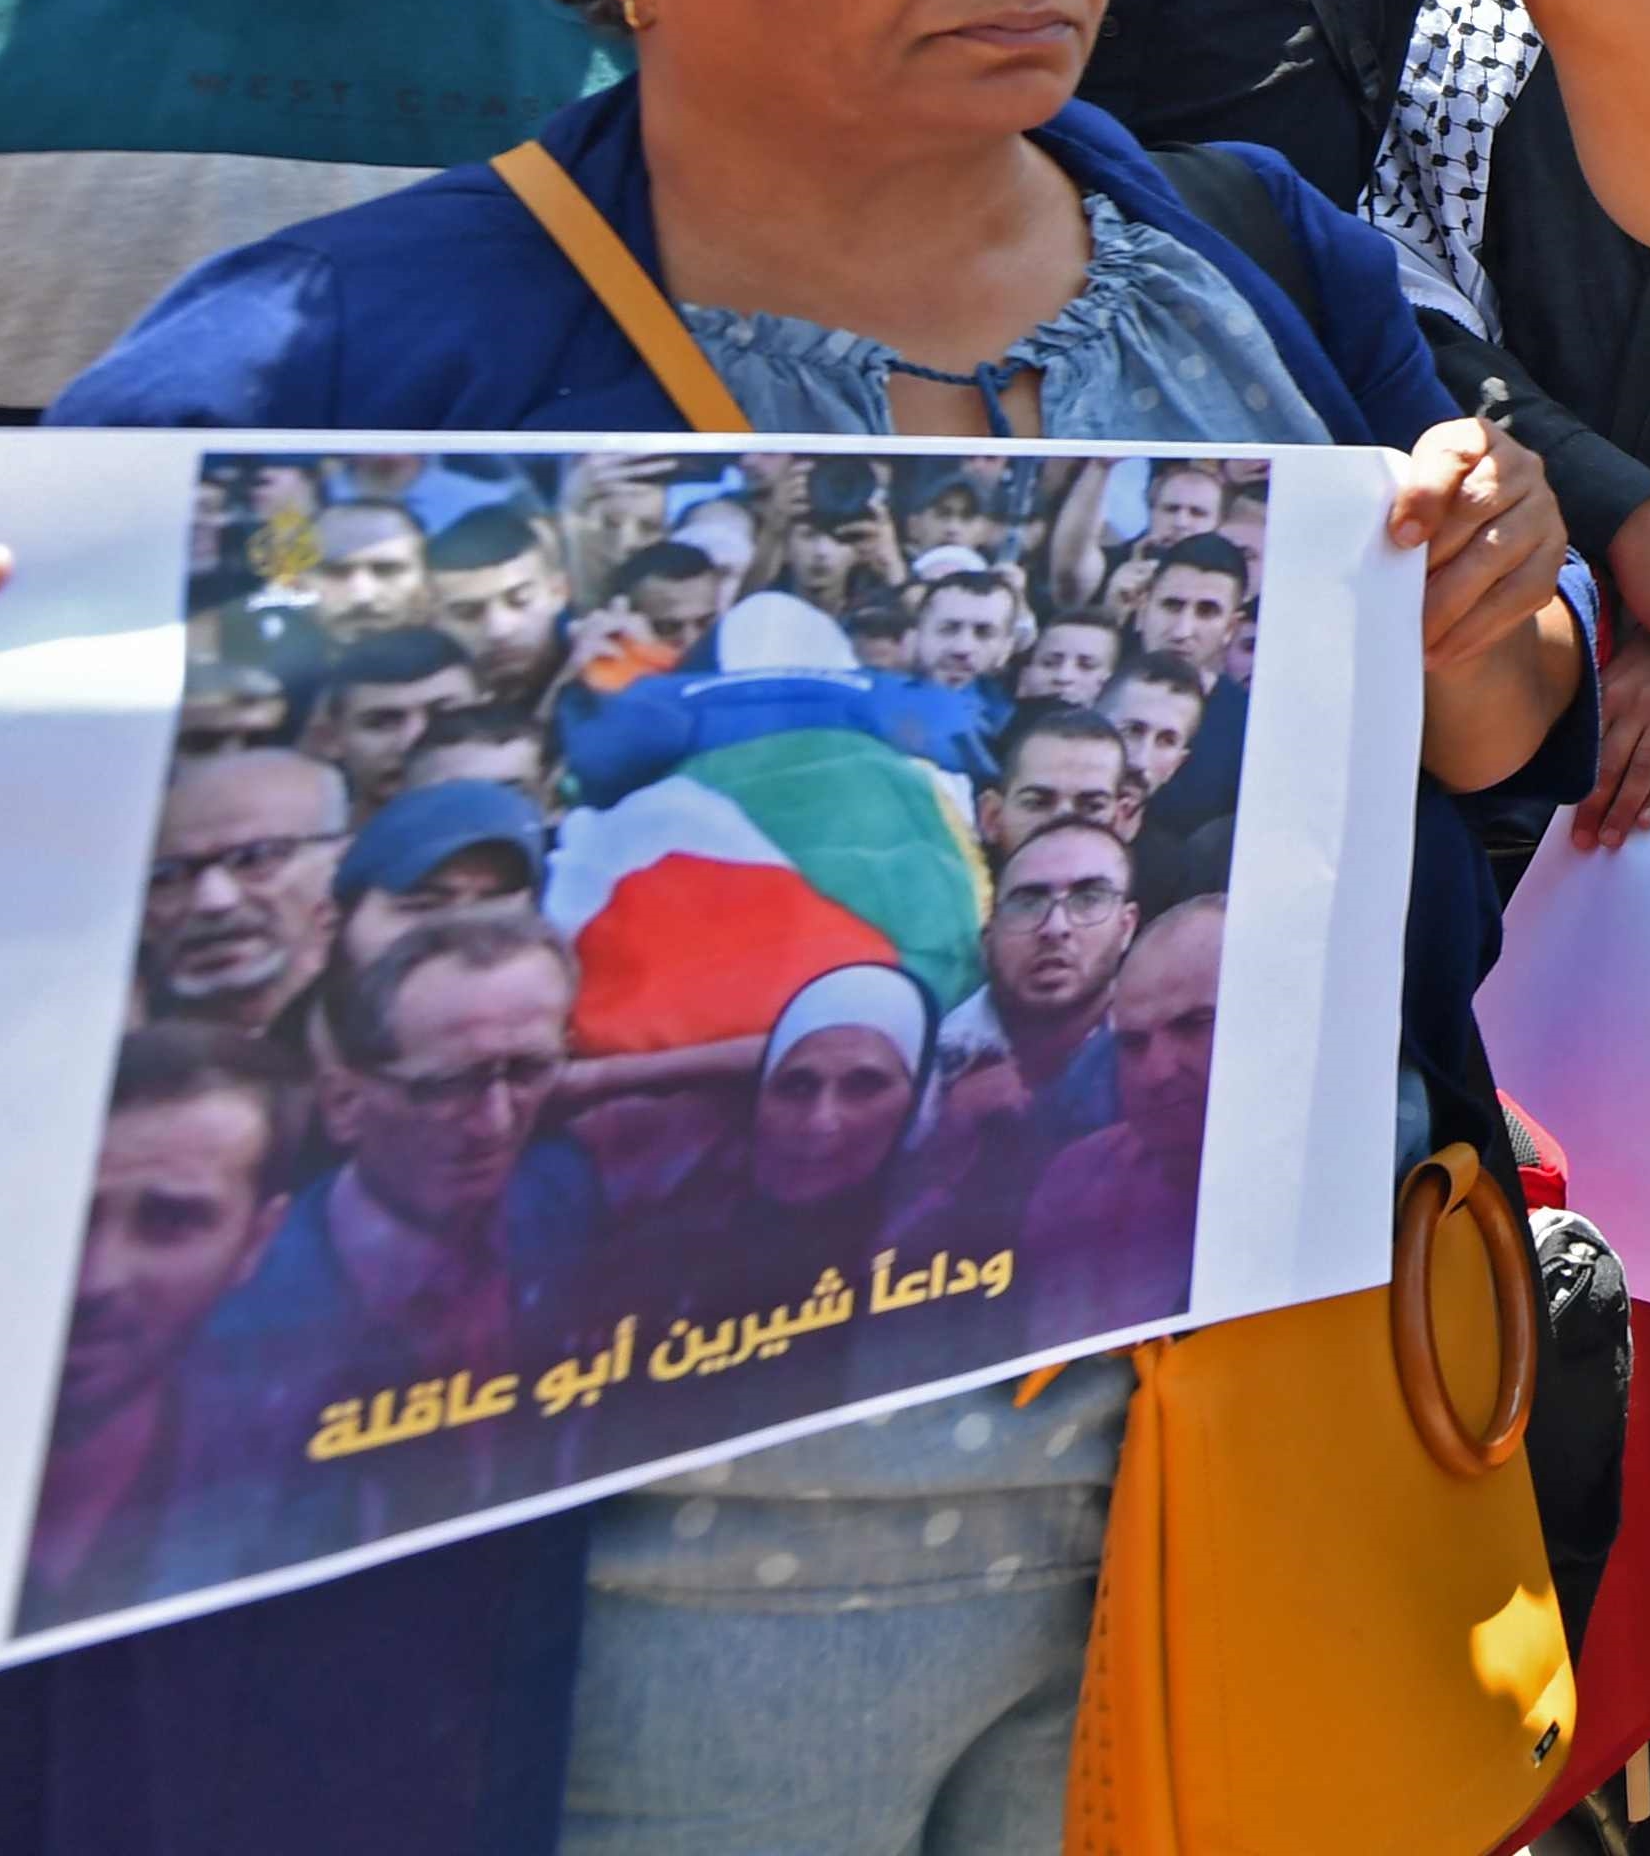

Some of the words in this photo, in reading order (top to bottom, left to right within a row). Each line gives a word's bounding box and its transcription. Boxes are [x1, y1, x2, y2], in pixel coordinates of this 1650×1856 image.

[645, 1265, 854, 1383] شيرين
[868, 1247, 1014, 1316] وداعاً
[304, 1367, 517, 1463] عاقلة
[534, 1315, 638, 1418] أبو
